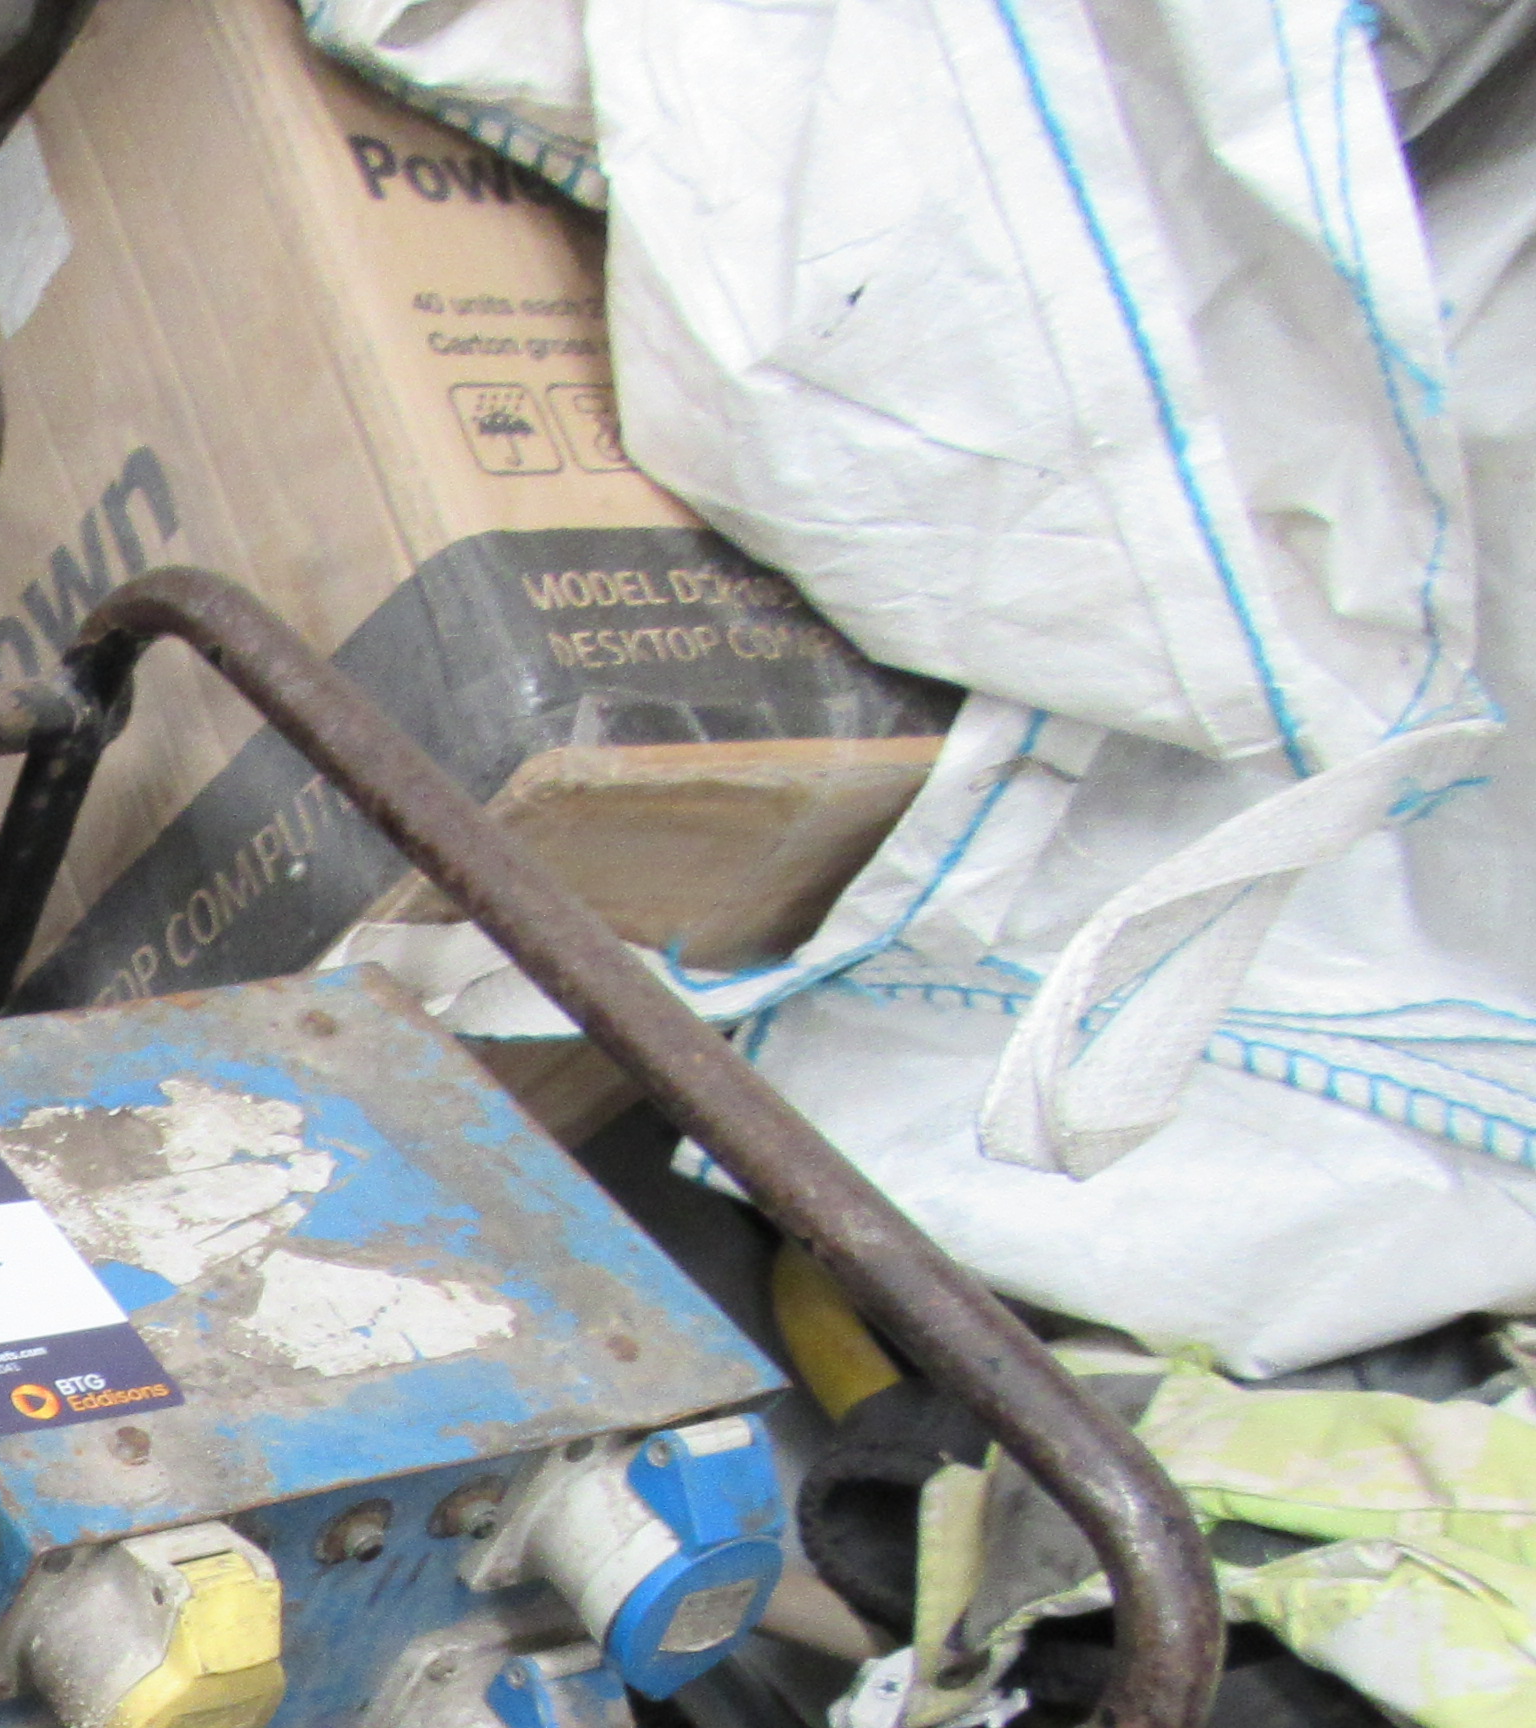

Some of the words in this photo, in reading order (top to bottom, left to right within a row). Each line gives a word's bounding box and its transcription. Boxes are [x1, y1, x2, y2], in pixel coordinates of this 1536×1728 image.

[450, 293, 515, 316] units
[428, 329, 524, 356] Carton
[522, 569, 671, 611] MODEL
[548, 625, 724, 669] DESKTOP
[164, 772, 355, 969] COMPUT
[53, 1372, 107, 1396] BTG
[65, 1382, 172, 1413] Eddisons
